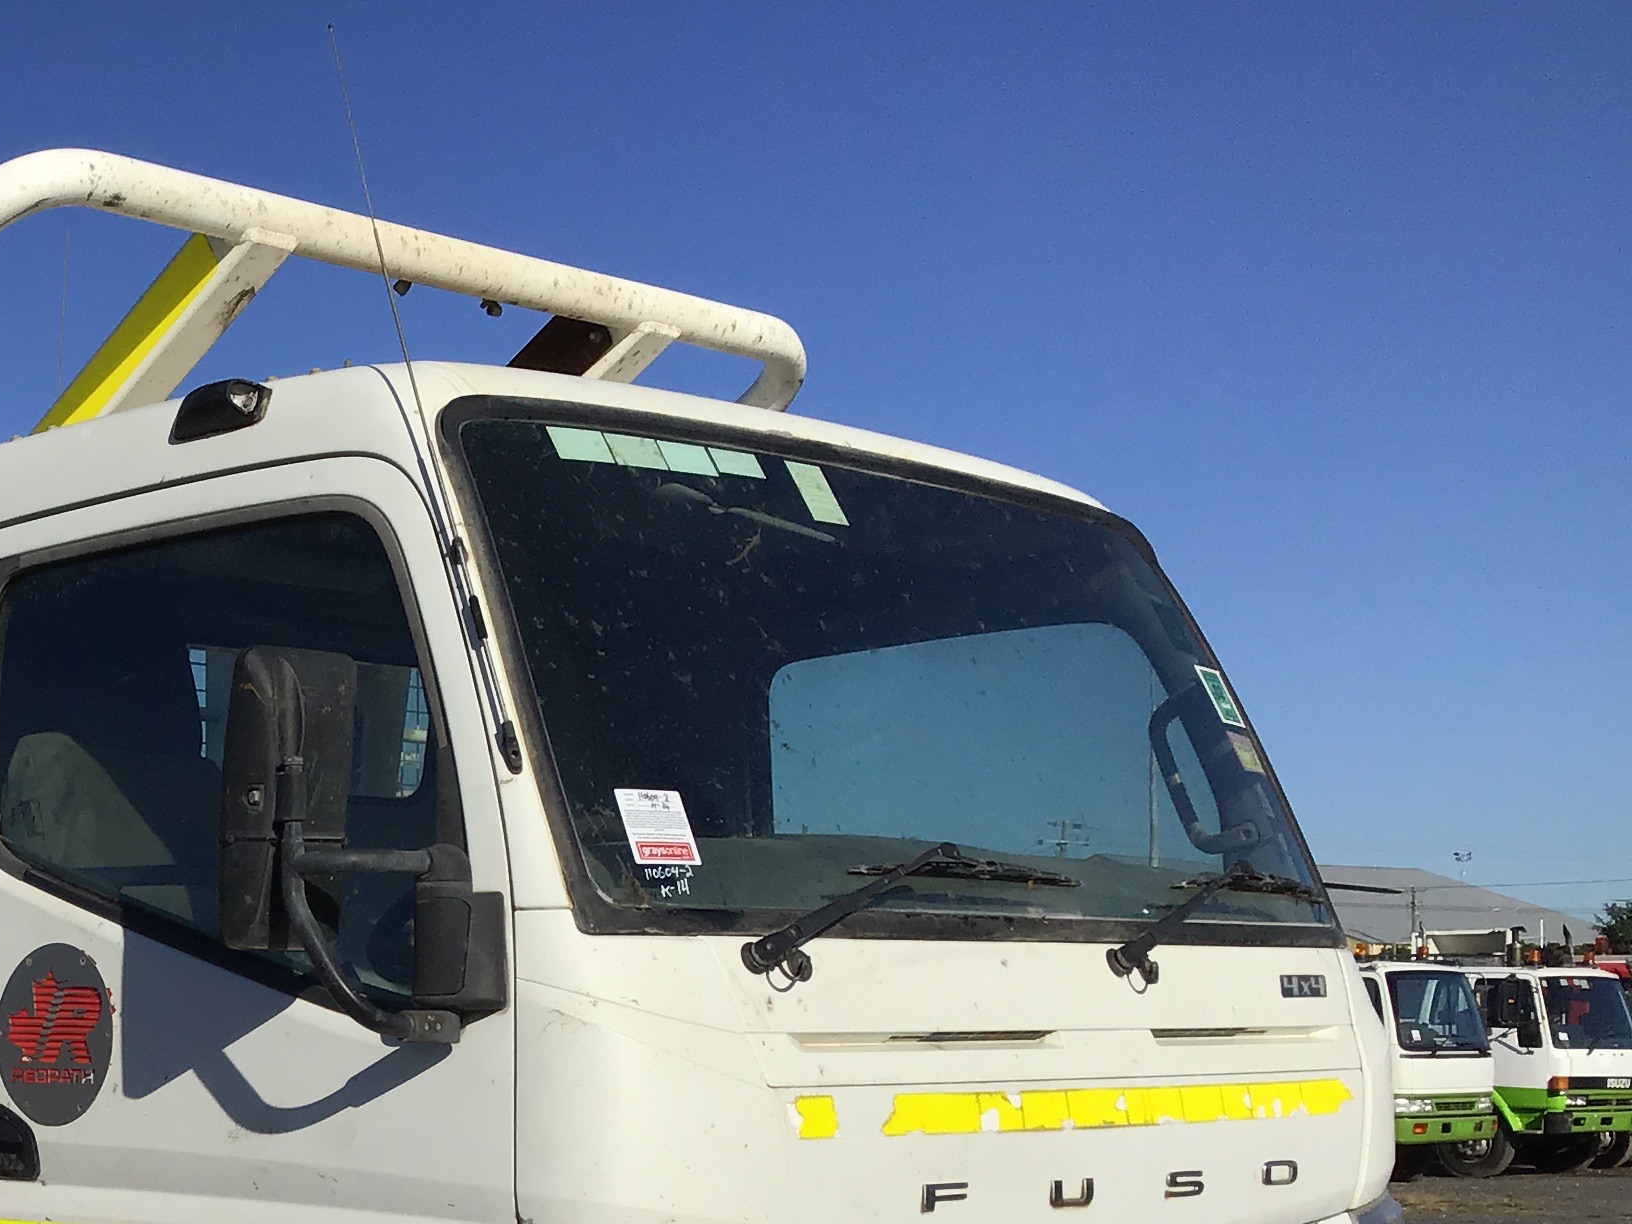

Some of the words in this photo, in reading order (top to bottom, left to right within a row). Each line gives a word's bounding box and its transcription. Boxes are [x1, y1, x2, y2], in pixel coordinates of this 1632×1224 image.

[644, 865, 694, 881] 110604-2
[11, 1066, 96, 1085] REDPATH
[1606, 1078, 1631, 1089] ISUZU
[919, 1158, 1300, 1214] FUSO
